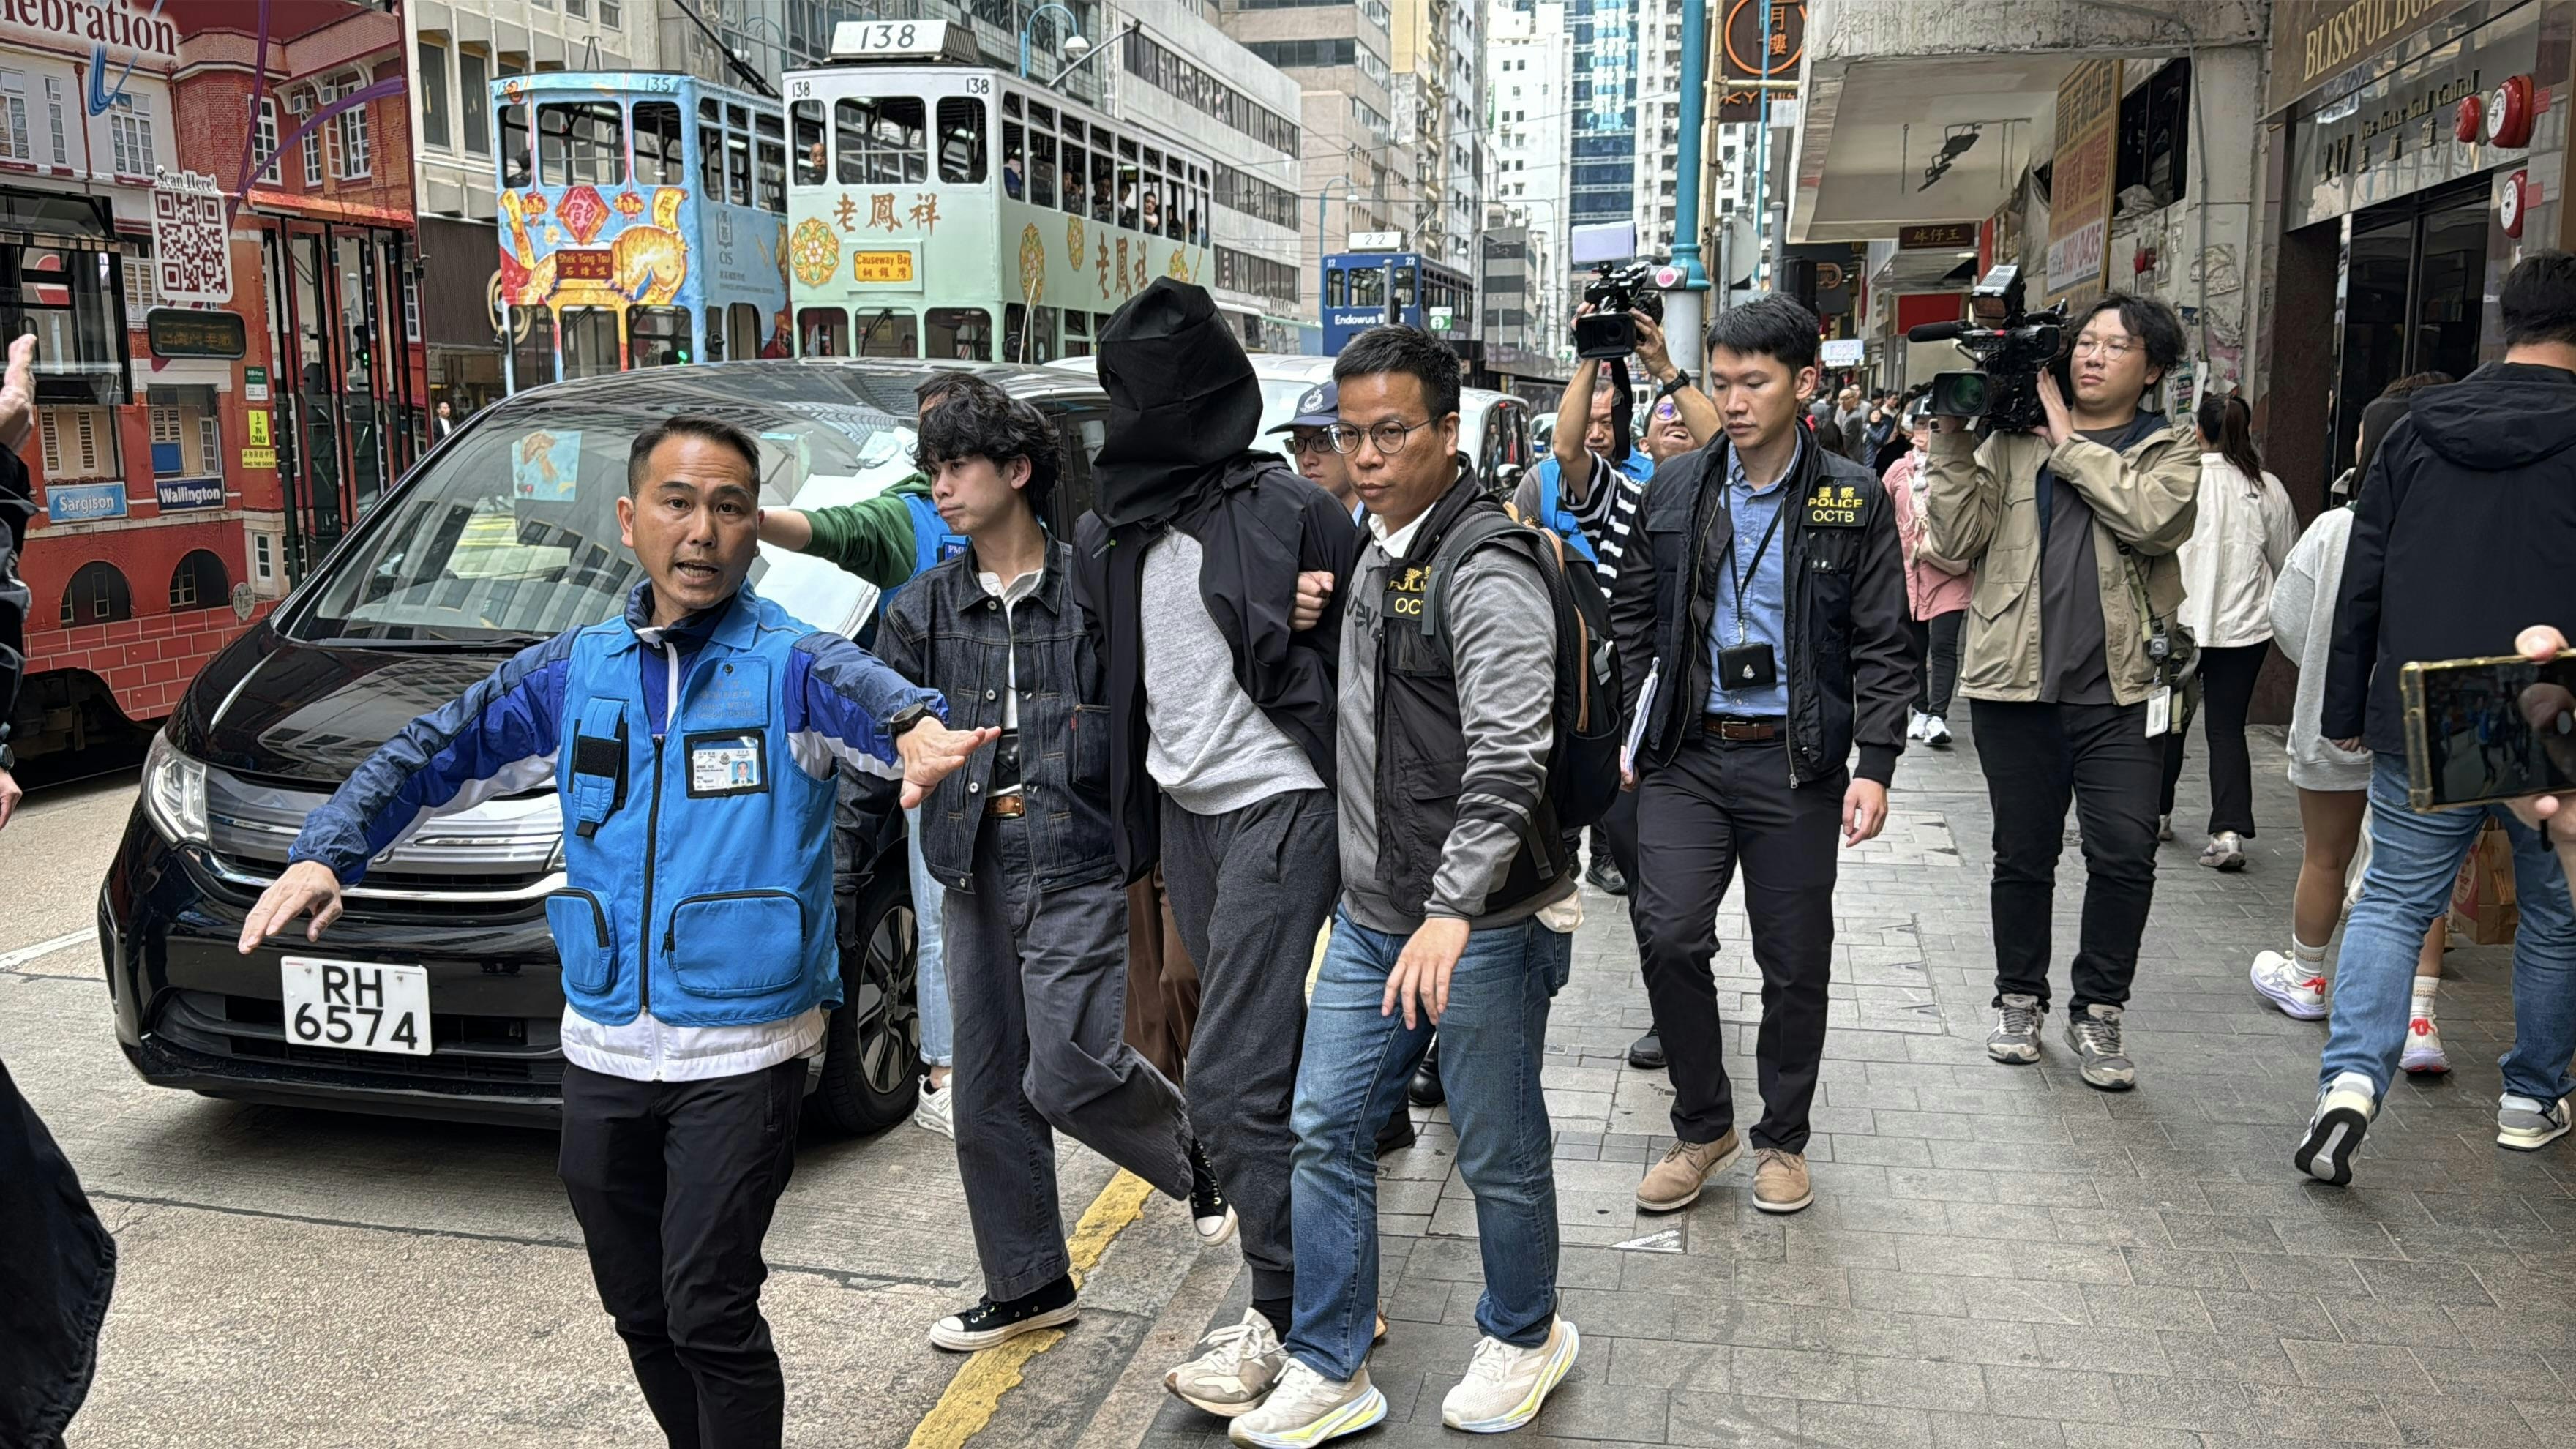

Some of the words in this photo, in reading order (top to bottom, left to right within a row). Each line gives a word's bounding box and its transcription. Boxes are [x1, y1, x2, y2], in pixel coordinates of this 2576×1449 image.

[0, 0, 176, 56] lebration
[861, 23, 916, 50] 138
[645, 76, 670, 92] 135
[792, 81, 811, 97] 138
[966, 78, 989, 94] 138
[187, 174, 216, 192] Here!
[833, 192, 941, 236] 老鳳祥
[1365, 233, 1386, 246] 22
[856, 254, 894, 266] Causeway
[897, 254, 912, 266] Bay
[1096, 230, 1149, 302] 老鳳祥
[1327, 258, 1336, 268] 22
[1405, 256, 1415, 266] 22
[1334, 314, 1376, 326] Endowus
[251, 435, 267, 443] ONLY
[59, 495, 114, 512] Sargison
[160, 486, 220, 505] Wallington
[1808, 497, 1863, 509] POLICE
[1812, 509, 1855, 523] OCTB
[1394, 597, 1425, 615] OC
[322, 965, 383, 1008] RH
[294, 1002, 419, 1051] 6574
